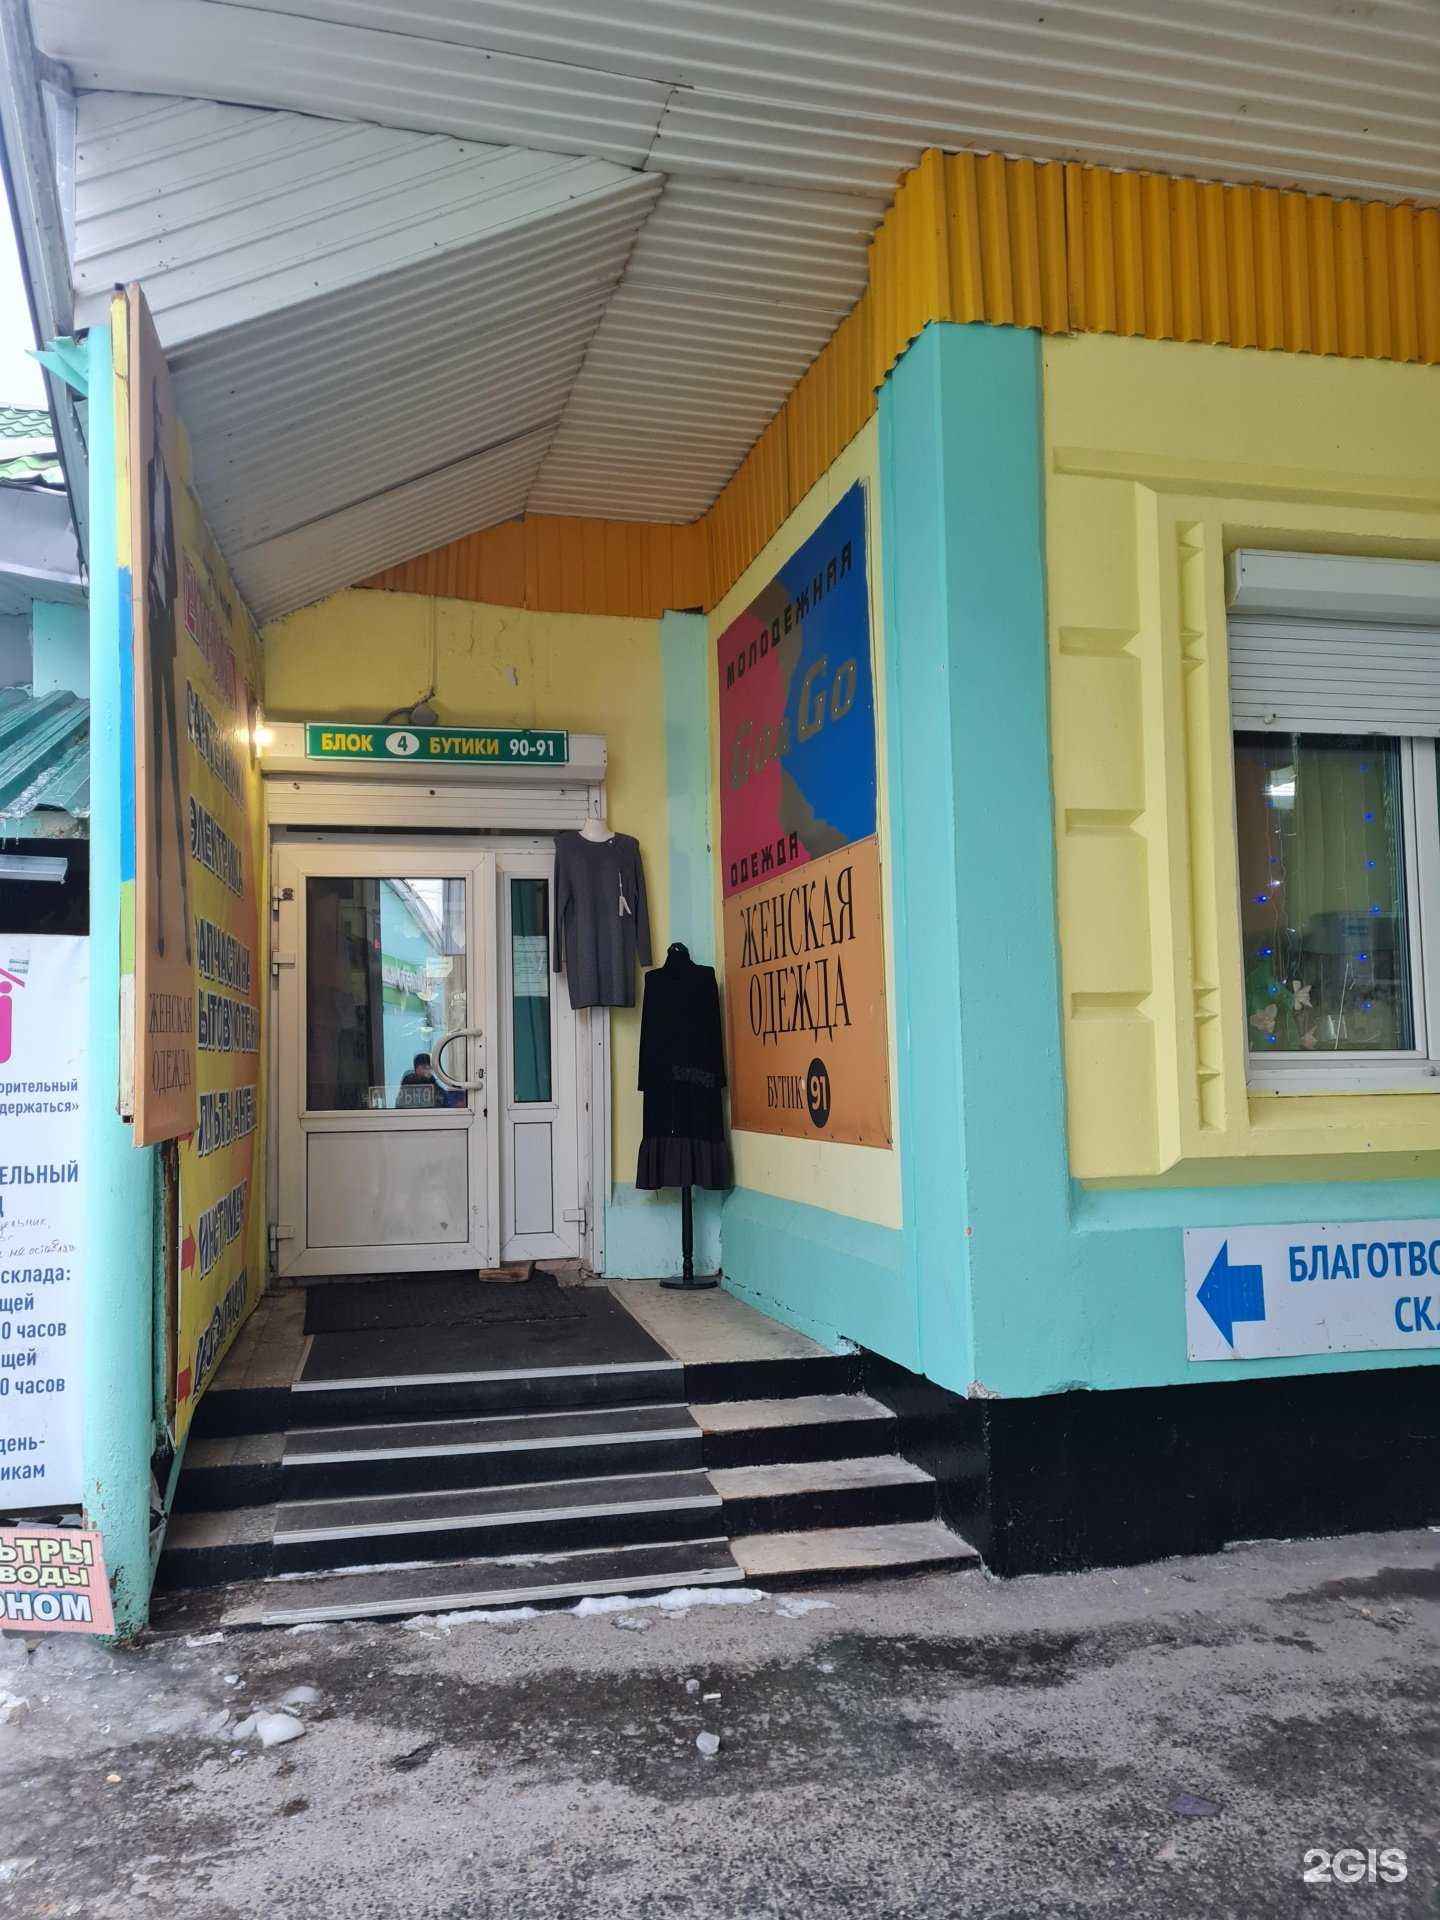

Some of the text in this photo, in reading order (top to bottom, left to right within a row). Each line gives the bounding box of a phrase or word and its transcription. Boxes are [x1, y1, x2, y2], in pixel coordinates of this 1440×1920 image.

[726, 540, 854, 689] МОЛОДЕЖНАЯ
[321, 733, 554, 757] БЛОК 4 БУТИКИ 90-91
[730, 831, 799, 887] ОДЕЖДА
[740, 866, 856, 968] ЖЕНСКАЯ
[749, 952, 852, 1046] ОДЕЖДА
[149, 992, 193, 1037] ЖЕНСКАЯ
[152, 1048, 191, 1096] ОДЕЖДА
[767, 1074, 828, 1112] БУТИК 91
[0, 1160, 78, 1185] ЕЛЬНЫЙ
[1, 1267, 71, 1285] склада:
[17, 1322, 67, 1339] часов
[1, 1348, 36, 1370] щей
[15, 1378, 66, 1395] часов
[1, 1464, 45, 1480] икам
[0, 1537, 94, 1566] ЬТРЫ
[0, 1564, 90, 1588] ВОДЫ
